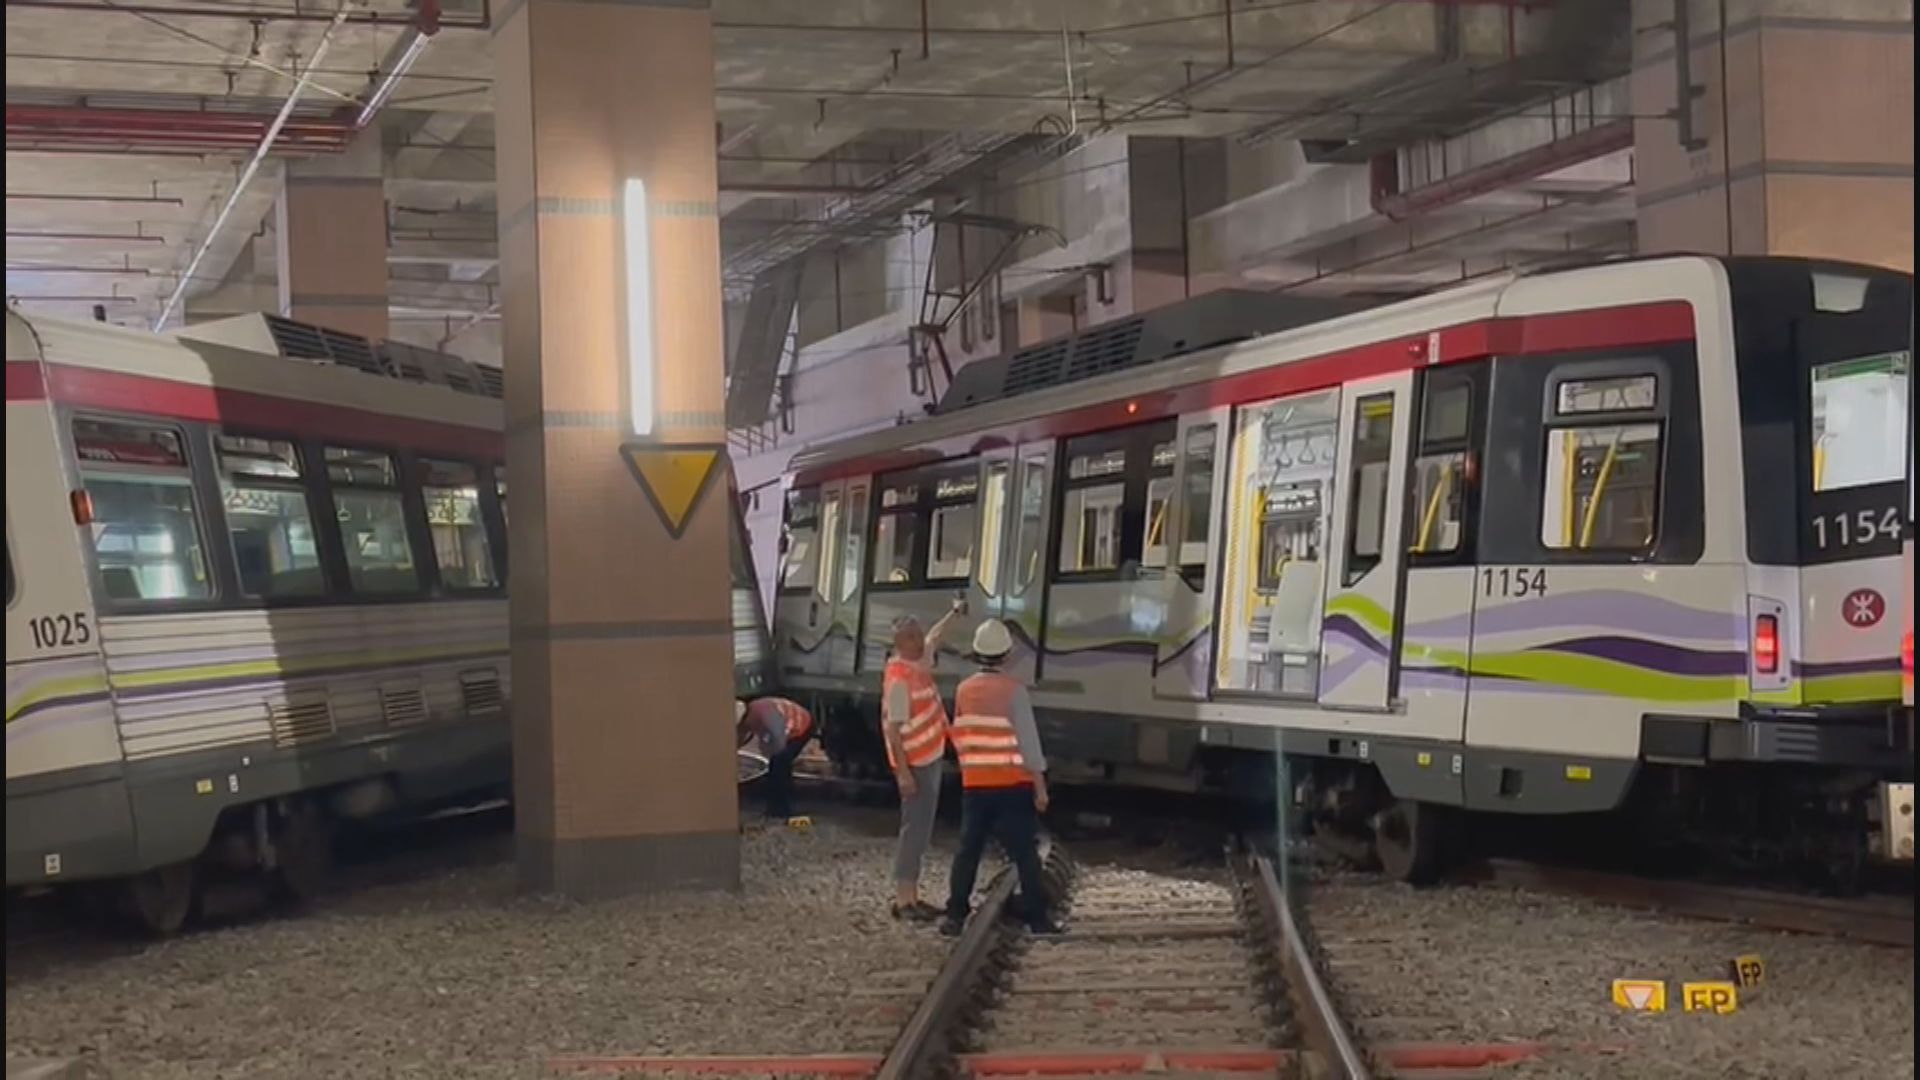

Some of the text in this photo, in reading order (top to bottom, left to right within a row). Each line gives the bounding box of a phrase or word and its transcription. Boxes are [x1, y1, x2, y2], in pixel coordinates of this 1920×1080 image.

[1812, 507, 1902, 549] 1154
[1482, 568, 1548, 597] 1154
[29, 612, 90, 648] 1025
[1740, 961, 1761, 988] FP
